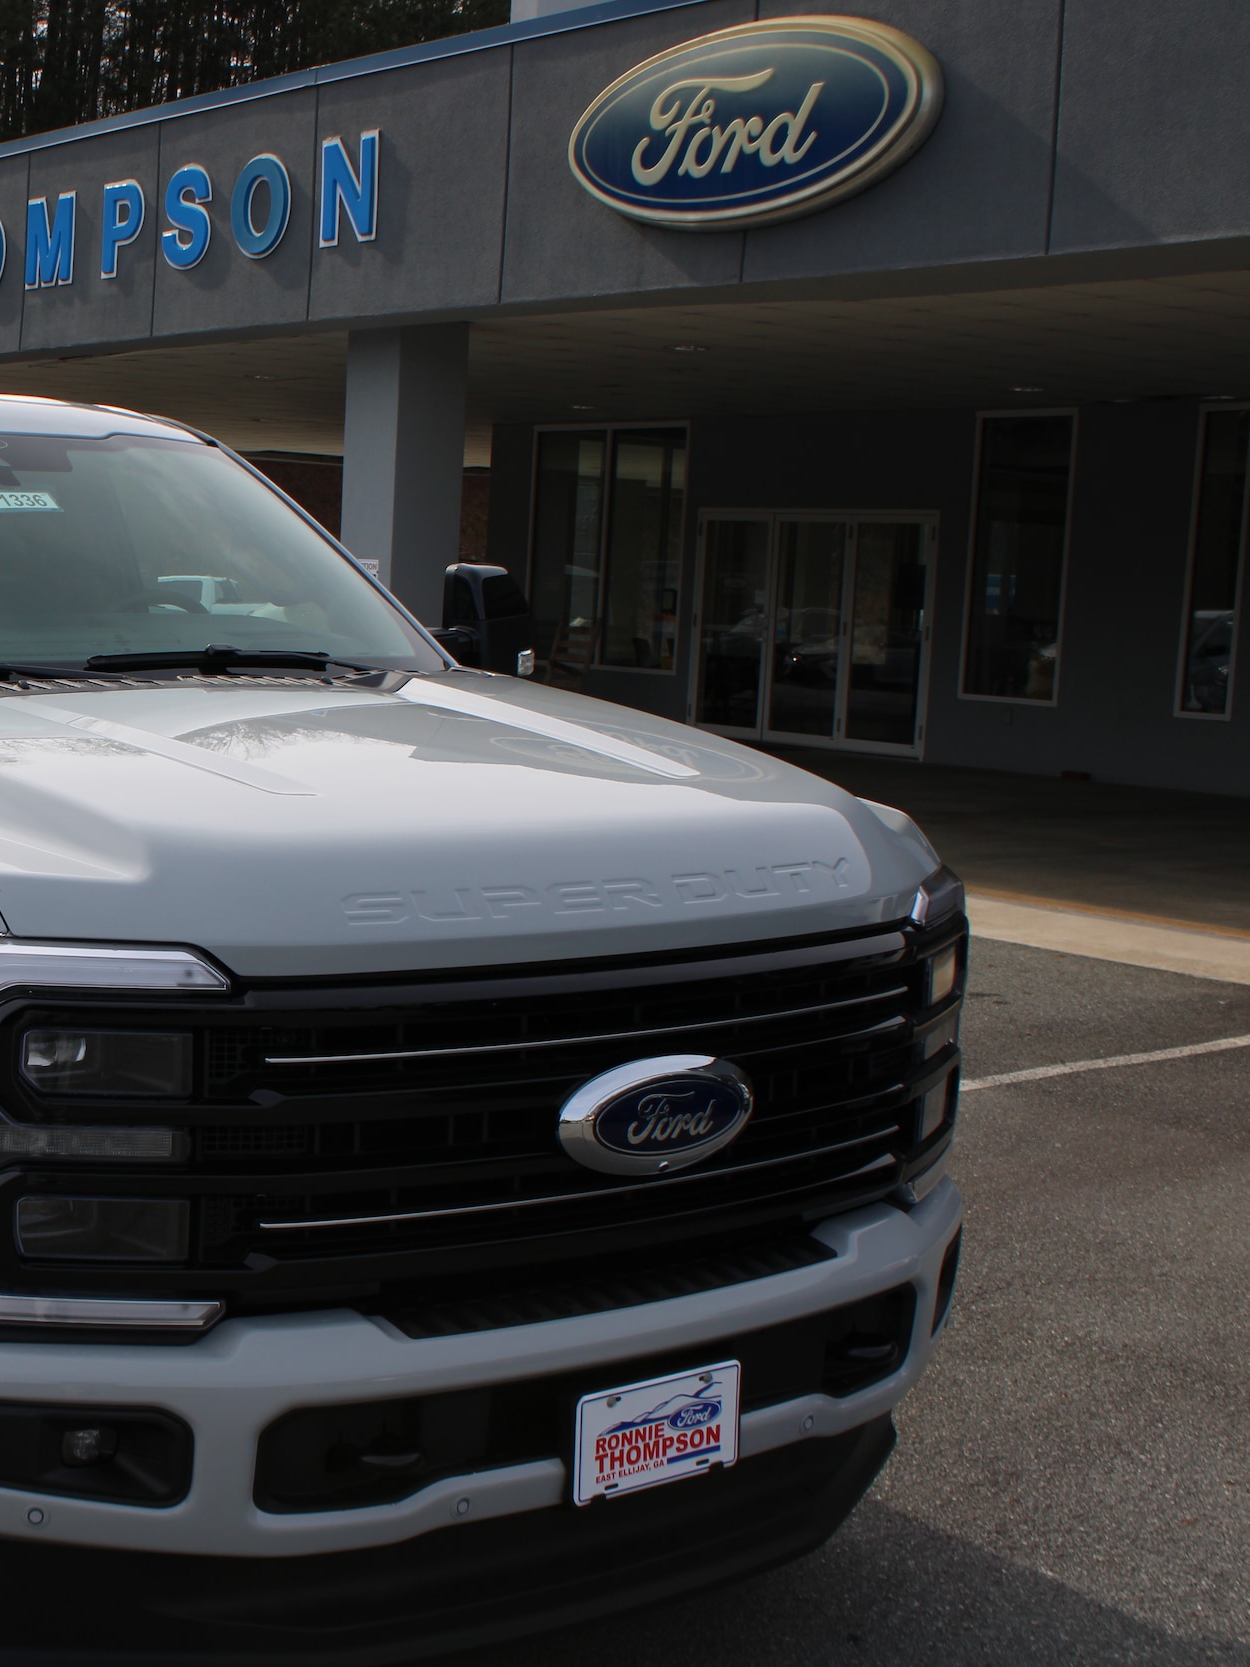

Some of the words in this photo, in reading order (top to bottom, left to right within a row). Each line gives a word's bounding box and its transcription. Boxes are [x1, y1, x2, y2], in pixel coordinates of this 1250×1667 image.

[631, 67, 825, 186] Ford
[342, 877, 663, 925] SUPER
[670, 857, 849, 905] DUTY
[627, 1091, 717, 1145] Ford
[595, 1422, 665, 1454] RONNIE
[676, 1403, 711, 1428] Ford
[594, 1424, 721, 1474] THOMPSON
[595, 1472, 616, 1484] EAST
[618, 1463, 652, 1479] ELLIJAY,
[653, 1460, 665, 1469] GA
